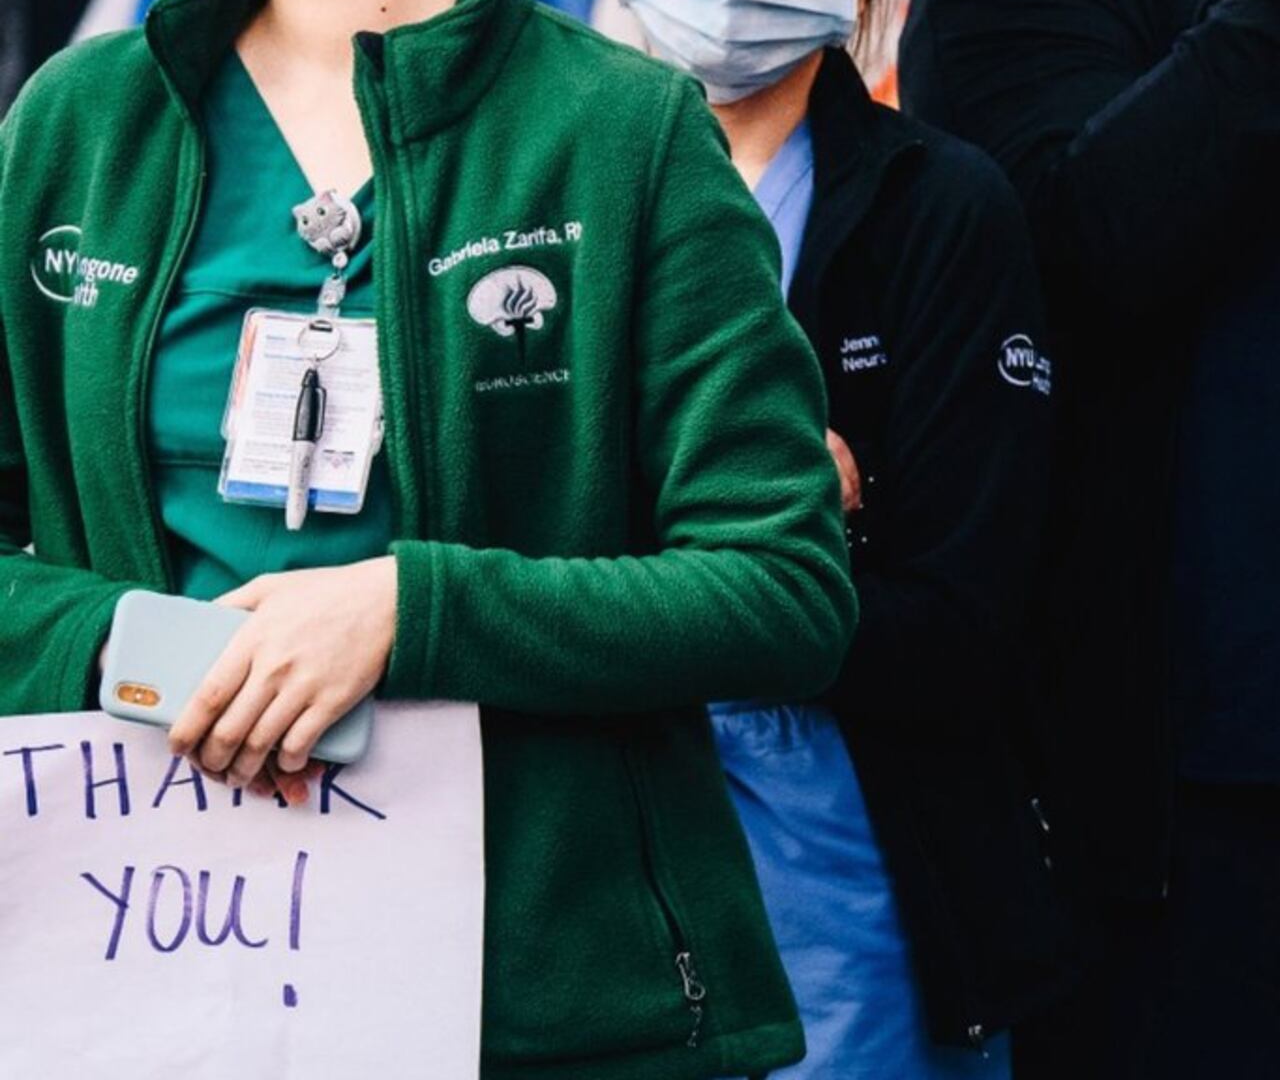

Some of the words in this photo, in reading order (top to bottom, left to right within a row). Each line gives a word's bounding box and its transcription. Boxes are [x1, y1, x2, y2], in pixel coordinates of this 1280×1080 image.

[44, 248, 79, 274] NY
[428, 236, 500, 276] Gabriela
[1006, 348, 1034, 368] NYU
[3, 740, 387, 820] THAK
[80, 850, 309, 1008] YOU!
